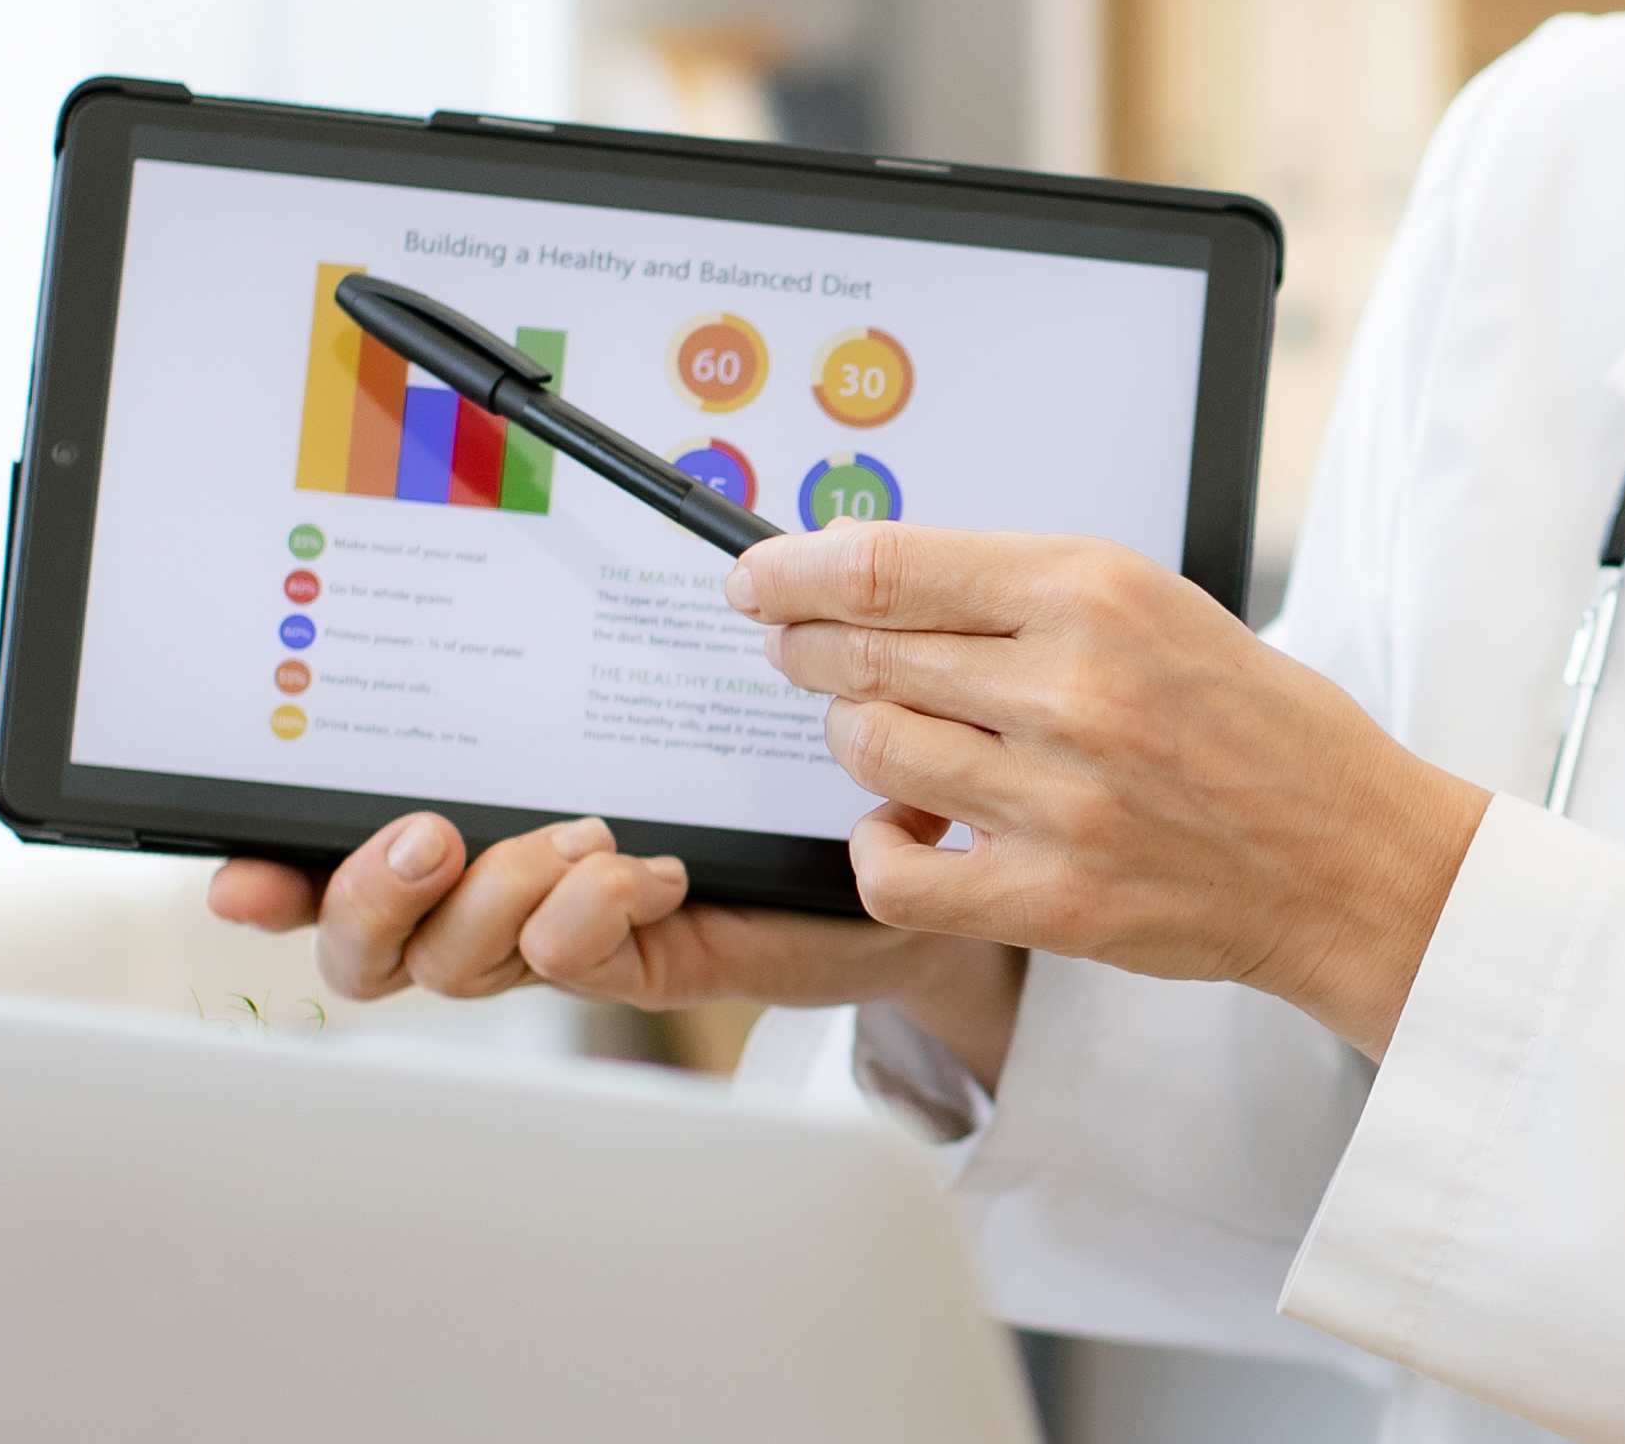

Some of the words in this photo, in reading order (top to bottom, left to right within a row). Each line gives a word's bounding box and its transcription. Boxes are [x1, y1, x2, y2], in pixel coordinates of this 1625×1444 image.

[404, 230, 506, 266] Building
[515, 246, 529, 263] a
[538, 245, 635, 280] Healthy
[643, 259, 690, 282] and
[700, 262, 812, 294] Balanced
[821, 274, 873, 299] Diet
[692, 349, 742, 386] 60
[839, 364, 886, 399] 30
[830, 489, 876, 519] 10
[334, 537, 367, 551] Make
[406, 544, 422, 555] of
[423, 549, 451, 561] your
[600, 565, 631, 582] THE
[637, 568, 685, 587] MAIN
[329, 583, 348, 595] Go
[351, 584, 368, 596] for
[372, 588, 410, 601] whole
[414, 593, 453, 607] grains
[597, 589, 618, 602] The
[624, 594, 651, 609] type
[656, 596, 670, 606] of
[595, 610, 658, 627] important
[663, 616, 693, 629] than
[374, 635, 413, 647] power
[650, 634, 700, 649] because
[320, 673, 368, 691] Healthy
[372, 678, 406, 692] plant
[589, 664, 622, 682] THE
[629, 667, 709, 689] HEALTHY
[714, 676, 777, 699] EATING
[588, 688, 610, 702] The
[614, 692, 662, 710] Healthy
[666, 698, 707, 715] Eating
[711, 701, 741, 716] Plate
[315, 716, 349, 731] Drink
[440, 732, 454, 742] or
[457, 731, 479, 744] tea
[627, 712, 674, 730] healthy
[707, 723, 731, 735] and
[665, 737, 737, 756] percentage
